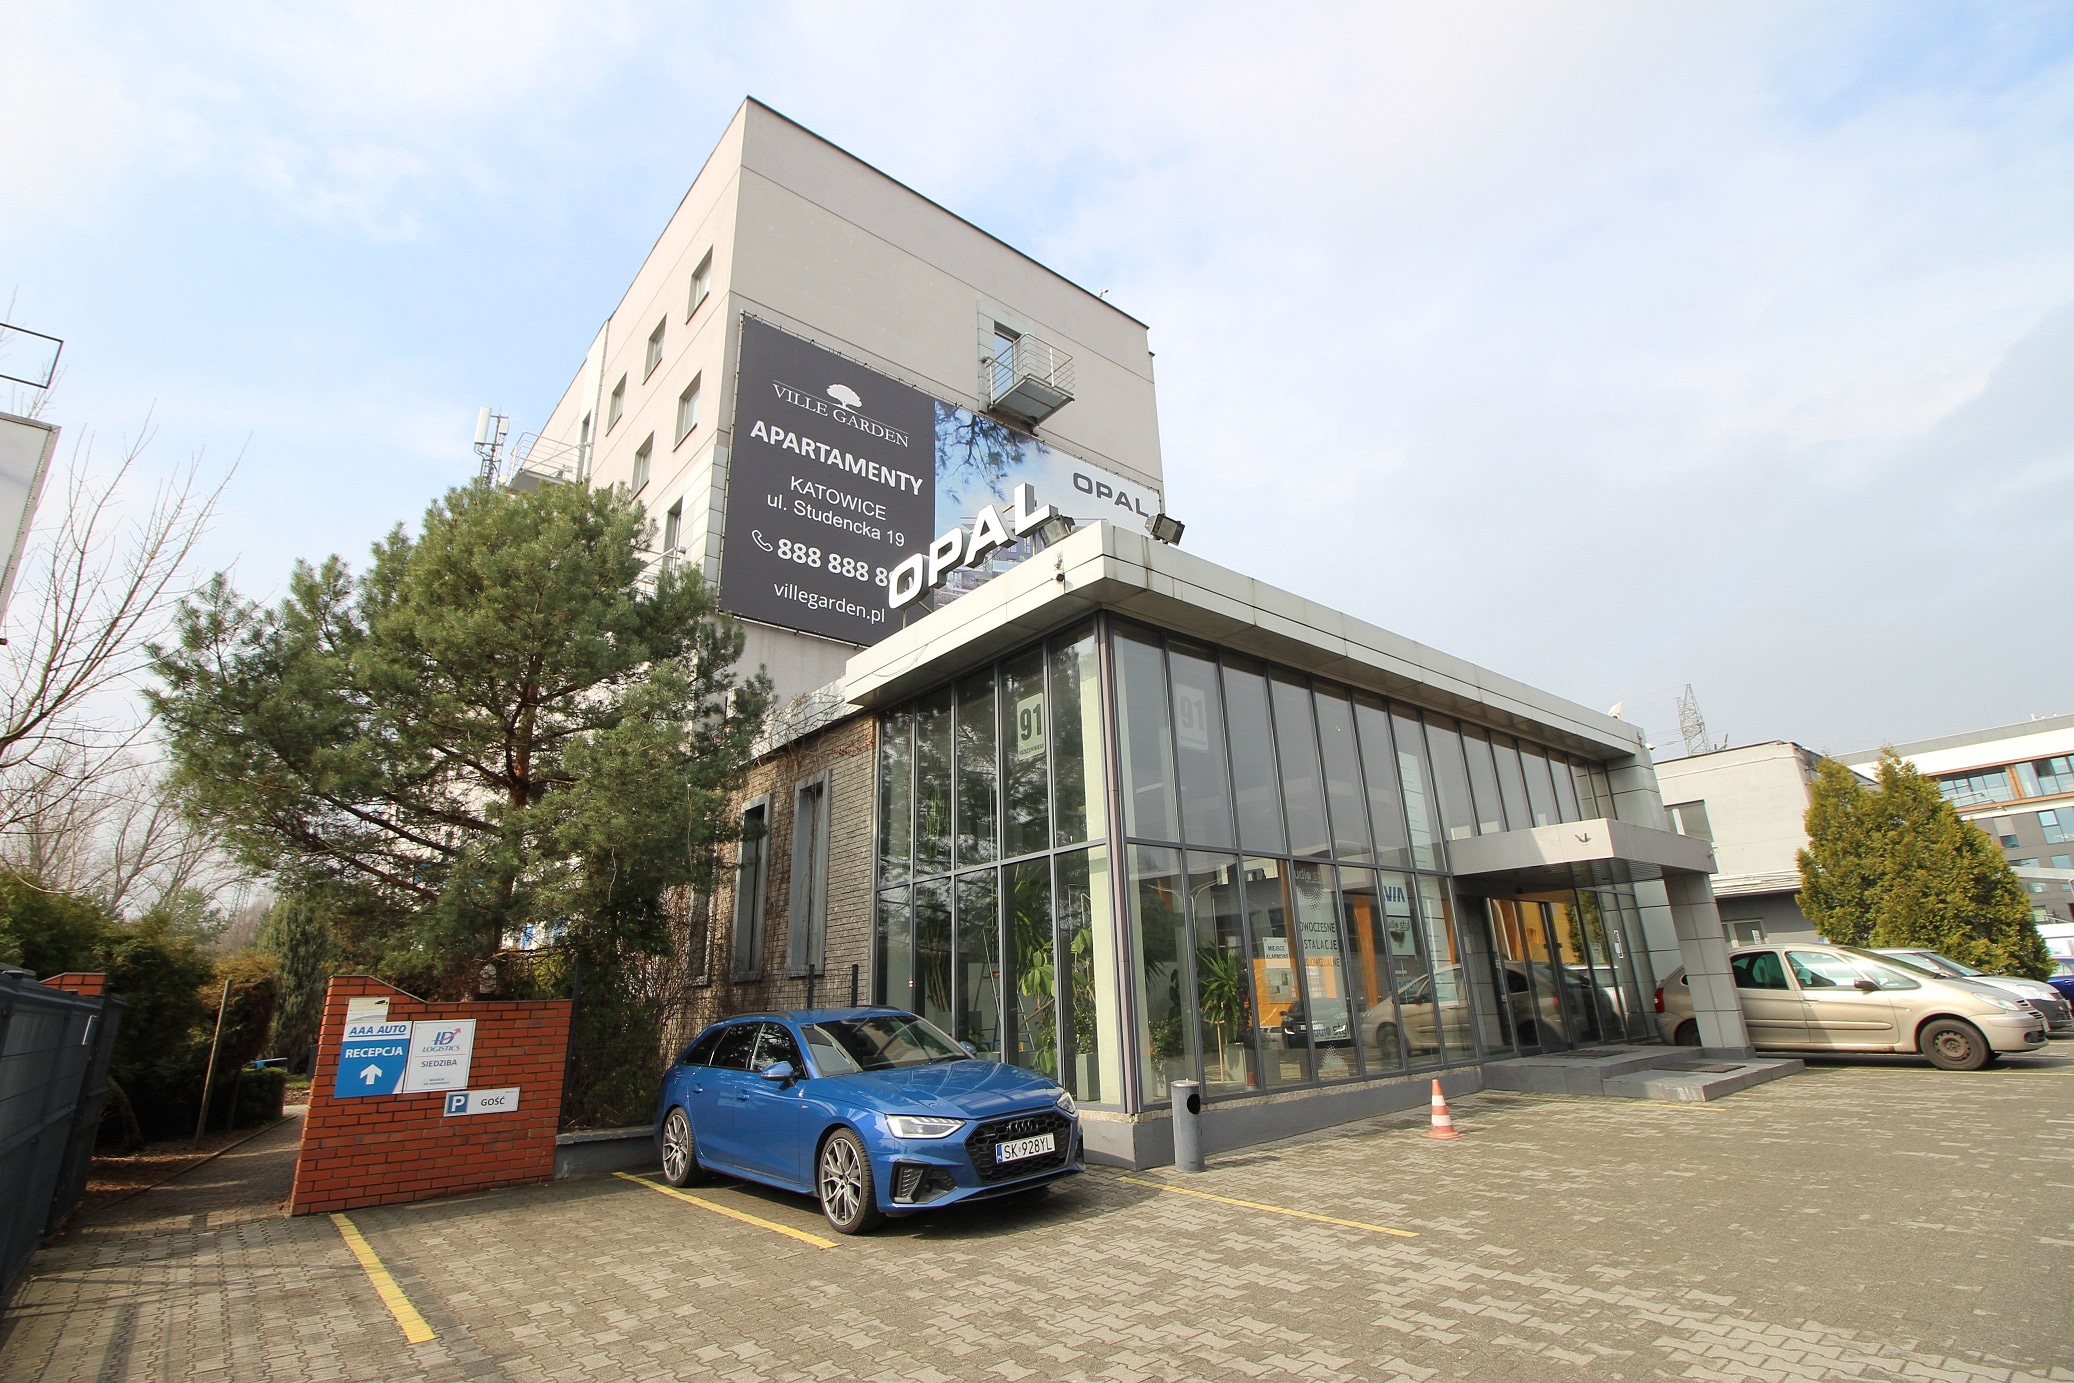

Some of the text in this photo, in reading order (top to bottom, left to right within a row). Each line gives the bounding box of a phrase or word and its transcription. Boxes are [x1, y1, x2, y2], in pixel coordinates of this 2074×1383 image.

[772, 383, 909, 448] VILLE GARDEN
[750, 420, 924, 496] APARTAMENTY
[790, 475, 887, 521] KATOWICE
[1072, 471, 1150, 518] OPAL
[767, 494, 905, 547] ul. Studencka 19
[777, 538, 822, 568] 888
[827, 553, 869, 582] 888
[888, 482, 1058, 610] OPAL
[773, 583, 886, 625] villegarden.pl
[1019, 703, 1042, 741] 91
[1300, 921, 1336, 933] OWOCZESNE
[1303, 939, 1338, 950] STALACJE
[349, 1024, 407, 1035] AAA AUTO
[433, 1031, 456, 1046] ID
[345, 1046, 403, 1059] RECEPCJA
[421, 1059, 458, 1068] SIEDZIBA
[422, 1044, 461, 1053] LOGISTICS
[451, 1095, 506, 1112] P GOŚĆ
[1003, 1136, 1053, 1160] SK 928YL
